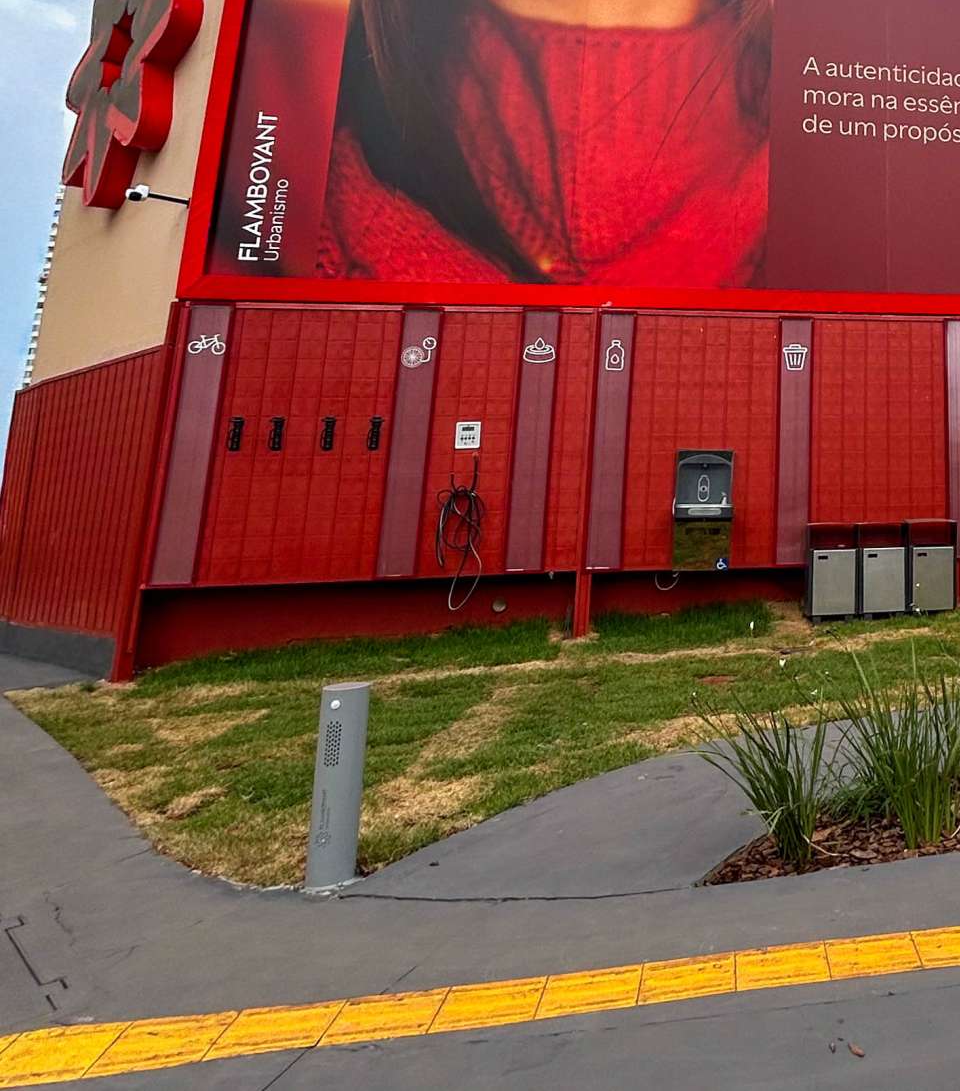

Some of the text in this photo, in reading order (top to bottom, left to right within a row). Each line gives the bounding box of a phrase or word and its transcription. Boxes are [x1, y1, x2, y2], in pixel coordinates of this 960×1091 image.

[802, 56, 820, 76] A
[803, 88, 864, 108] mora
[871, 94, 897, 110] na
[802, 114, 833, 134] de
[839, 121, 876, 137] um
[238, 111, 279, 261] FLAMBOYANT
[263, 178, 289, 262] Urbanismo
